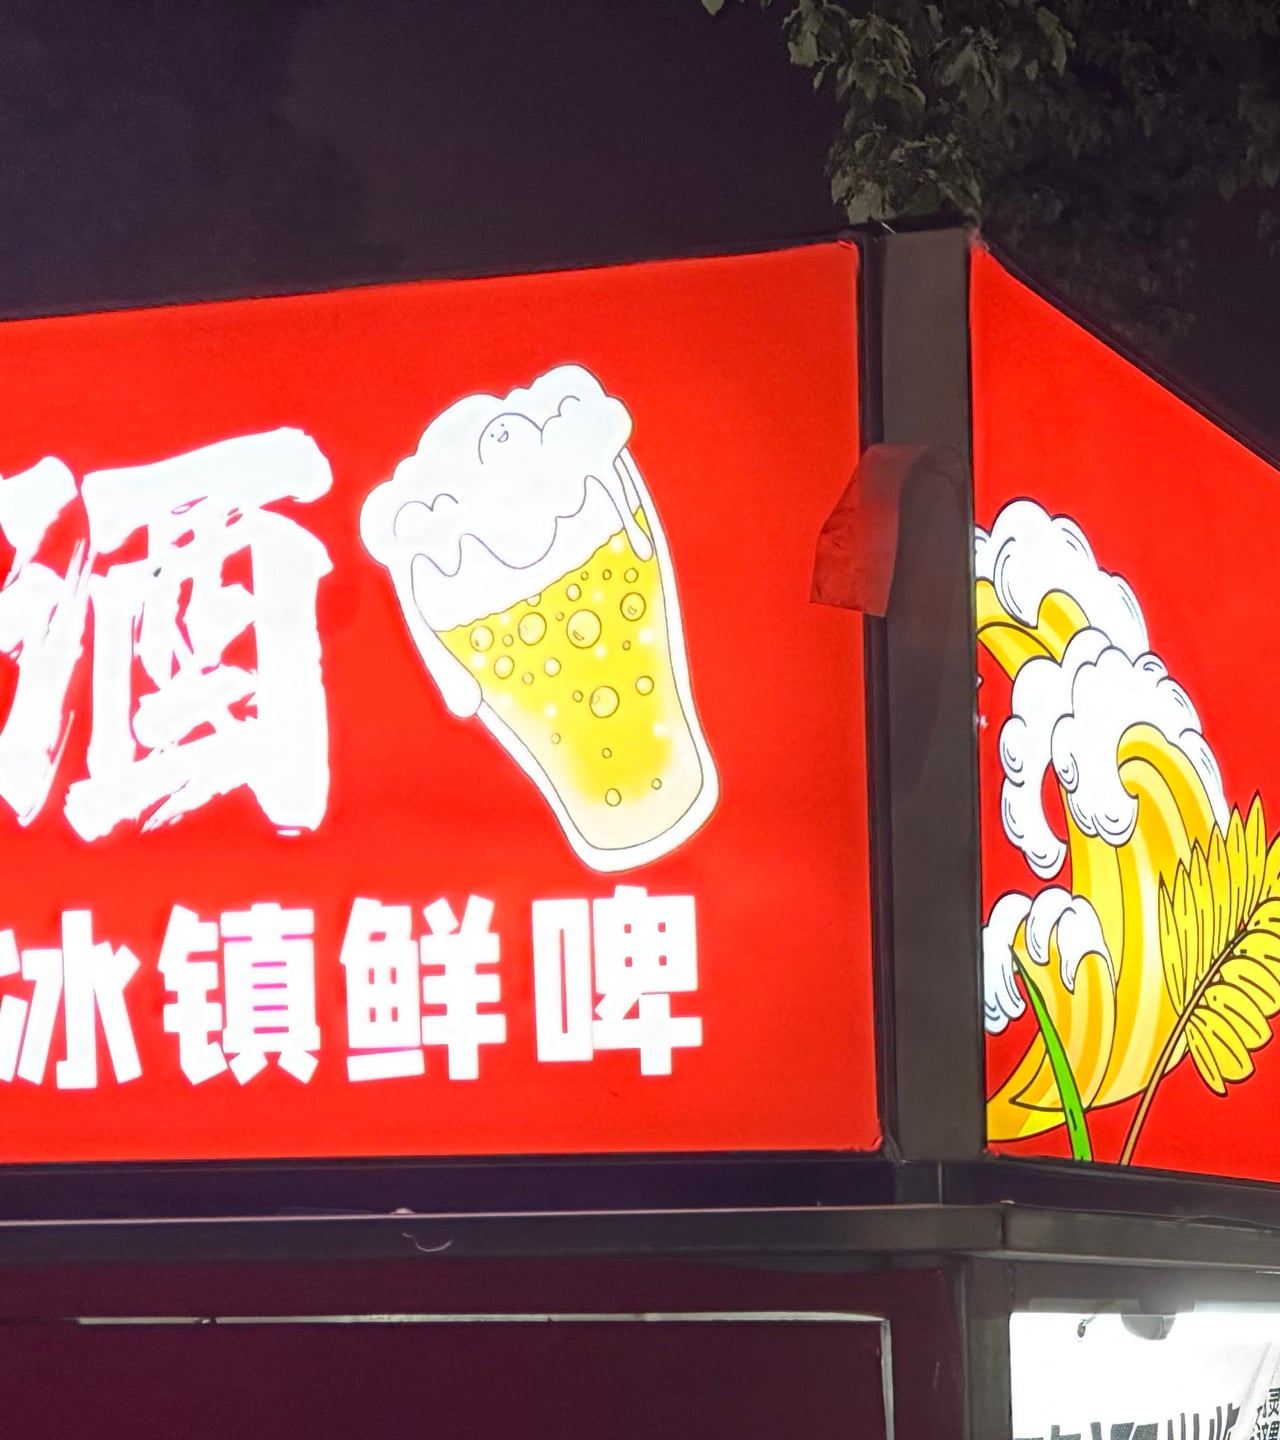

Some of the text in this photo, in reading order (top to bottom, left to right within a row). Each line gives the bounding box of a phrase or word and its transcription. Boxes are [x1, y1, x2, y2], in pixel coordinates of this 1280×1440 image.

[0, 427, 333, 842] 酒
[0, 886, 703, 1090] 冰镇鲜啤
